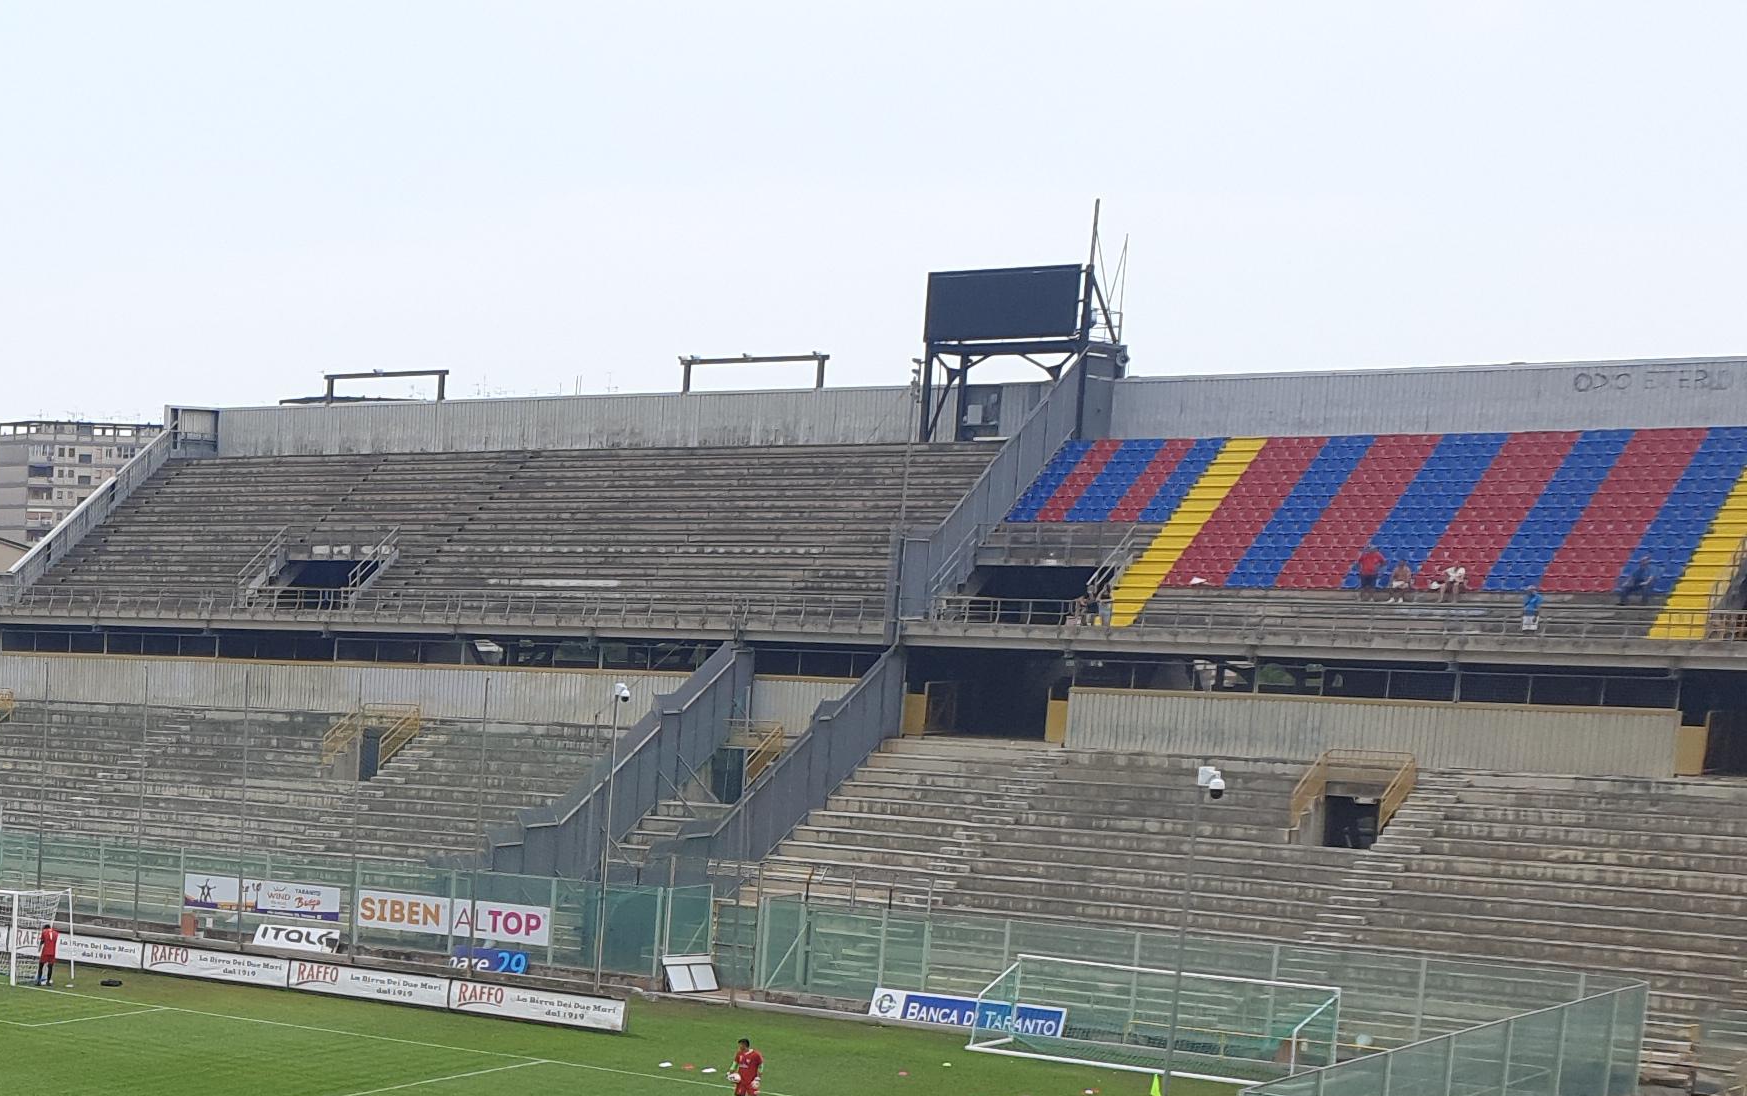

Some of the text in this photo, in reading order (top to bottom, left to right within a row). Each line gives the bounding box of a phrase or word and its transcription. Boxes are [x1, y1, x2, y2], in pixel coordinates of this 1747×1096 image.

[266, 890, 292, 901] WIND
[360, 897, 441, 926] SIBEN
[150, 944, 190, 964] RAFFO
[497, 952, 528, 973] 29
[297, 963, 340, 984] RAFFO
[458, 983, 505, 1005] RAFFO
[515, 994, 528, 1003] La
[559, 999, 575, 1009] Dei
[576, 1001, 592, 1011] Due
[593, 1003, 617, 1015] Mari
[545, 1008, 561, 1018] dal
[906, 1002, 1056, 1036] BANCA D TARANTO
